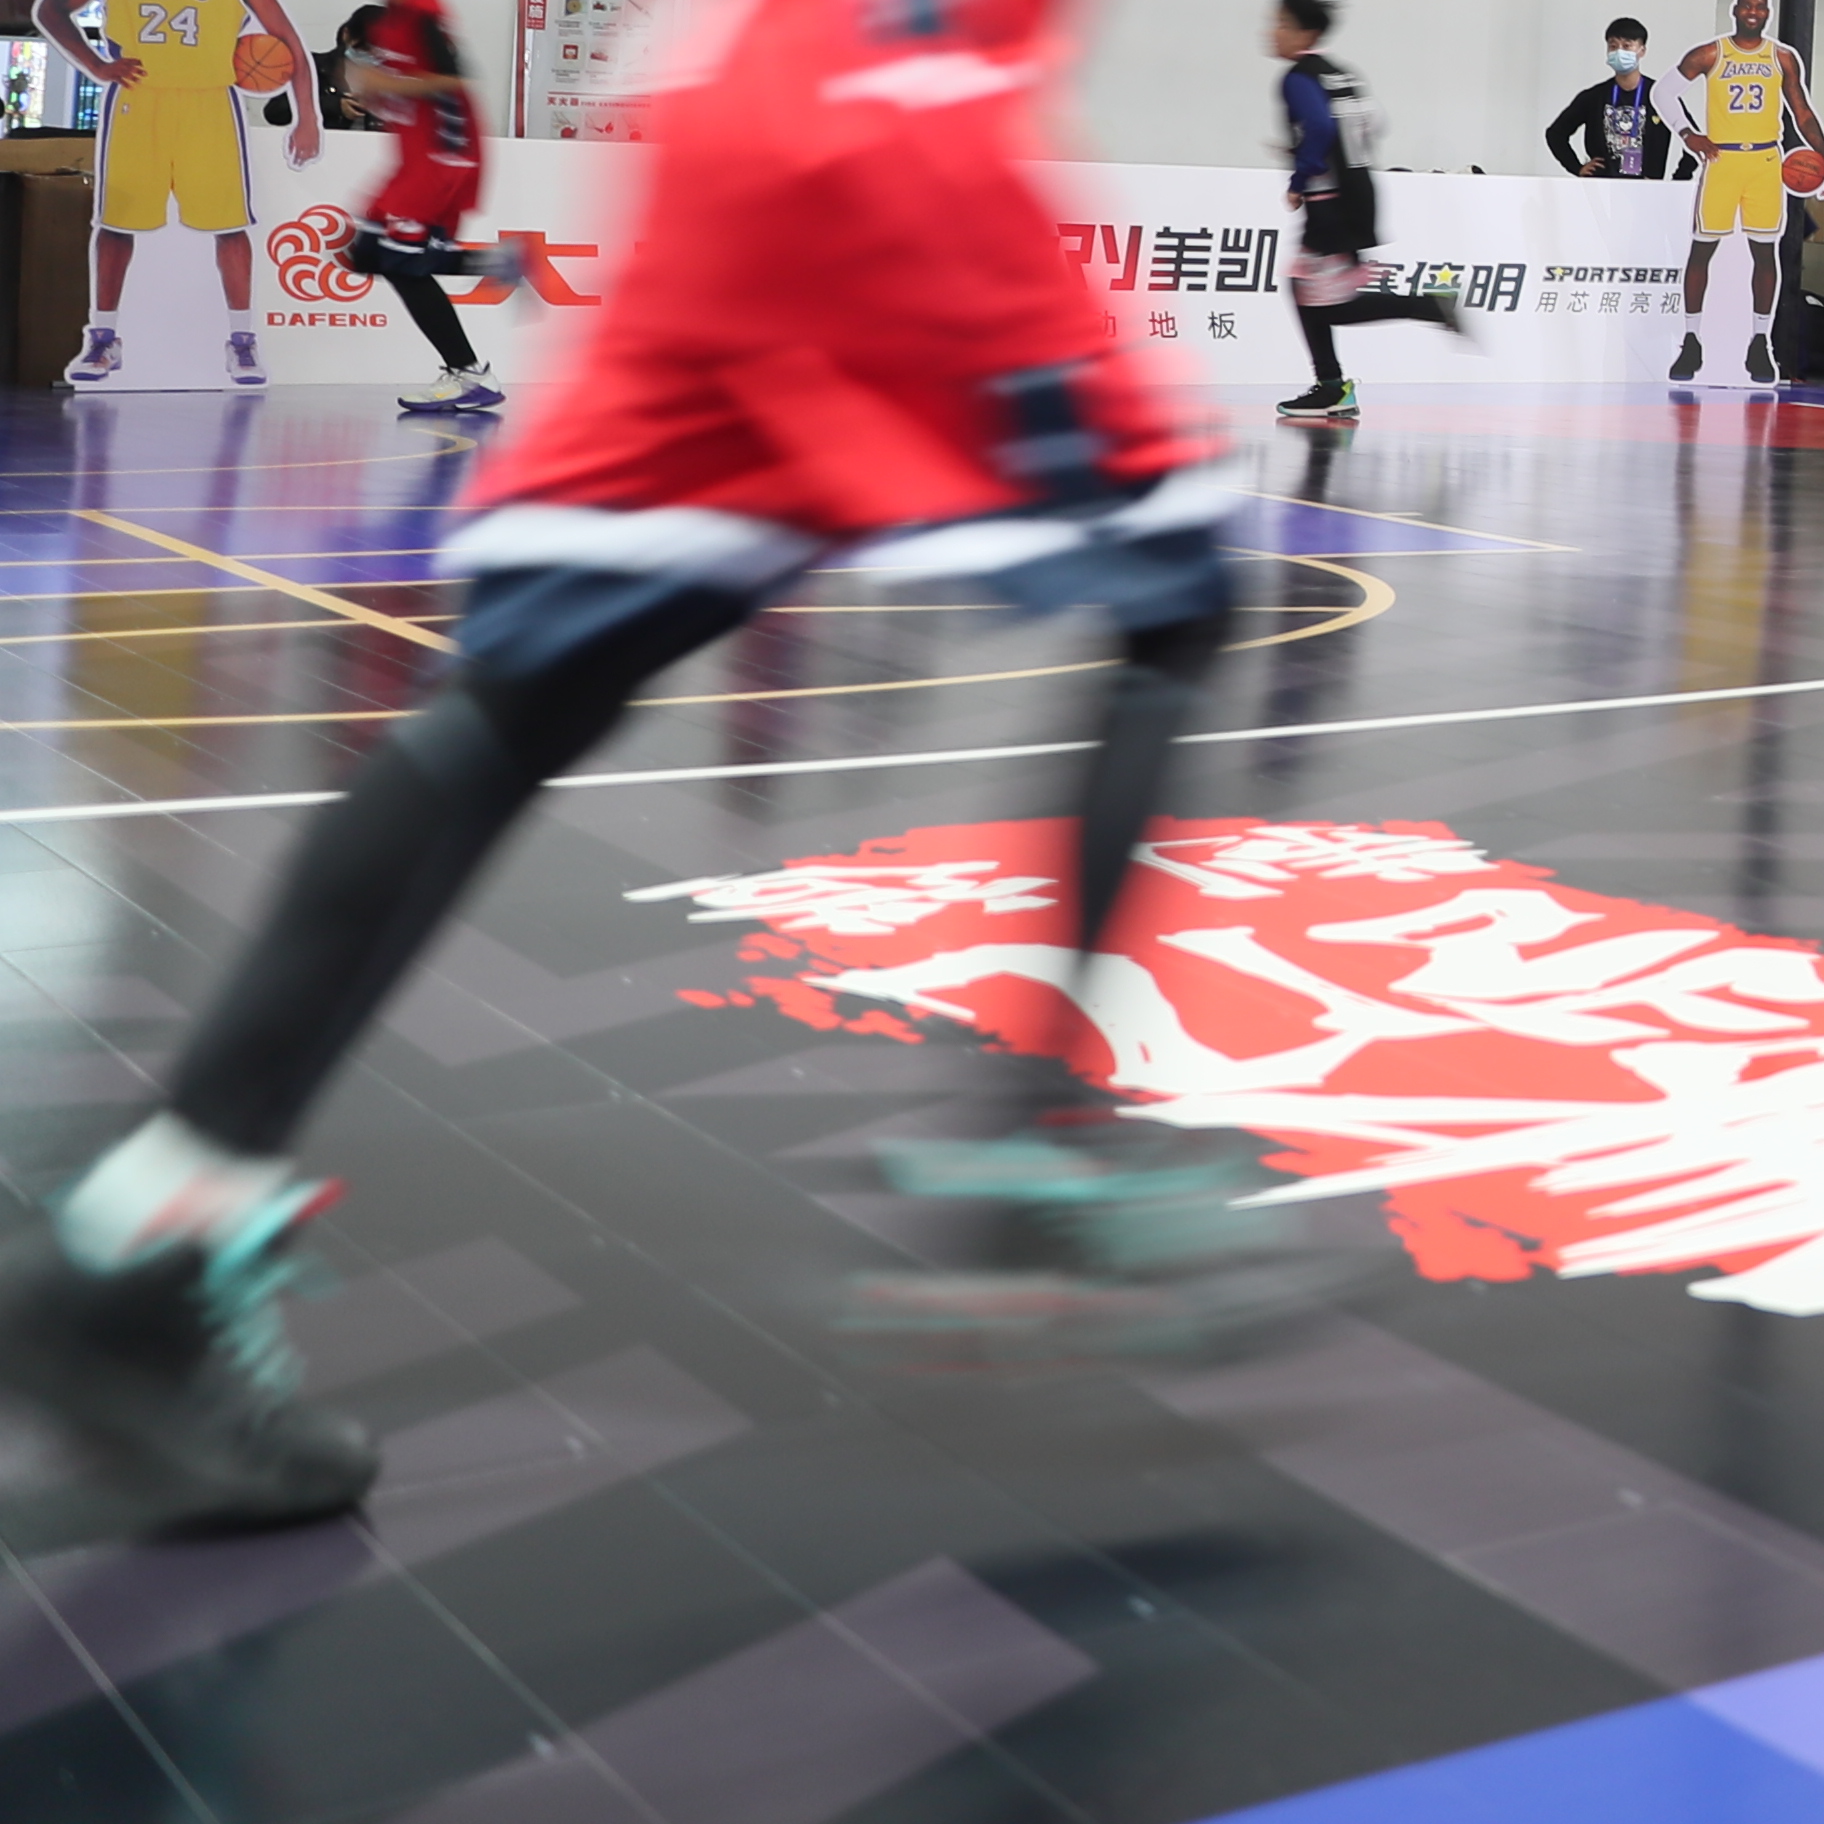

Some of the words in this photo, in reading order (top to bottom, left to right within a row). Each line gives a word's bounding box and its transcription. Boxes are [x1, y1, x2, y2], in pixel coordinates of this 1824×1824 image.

[139, 4, 199, 46] 24
[1719, 60, 1773, 80] LAKERS
[1728, 83, 1764, 112] 23
[1541, 266, 1683, 285] SPORTSBEA
[266, 312, 388, 328] DAFENG
